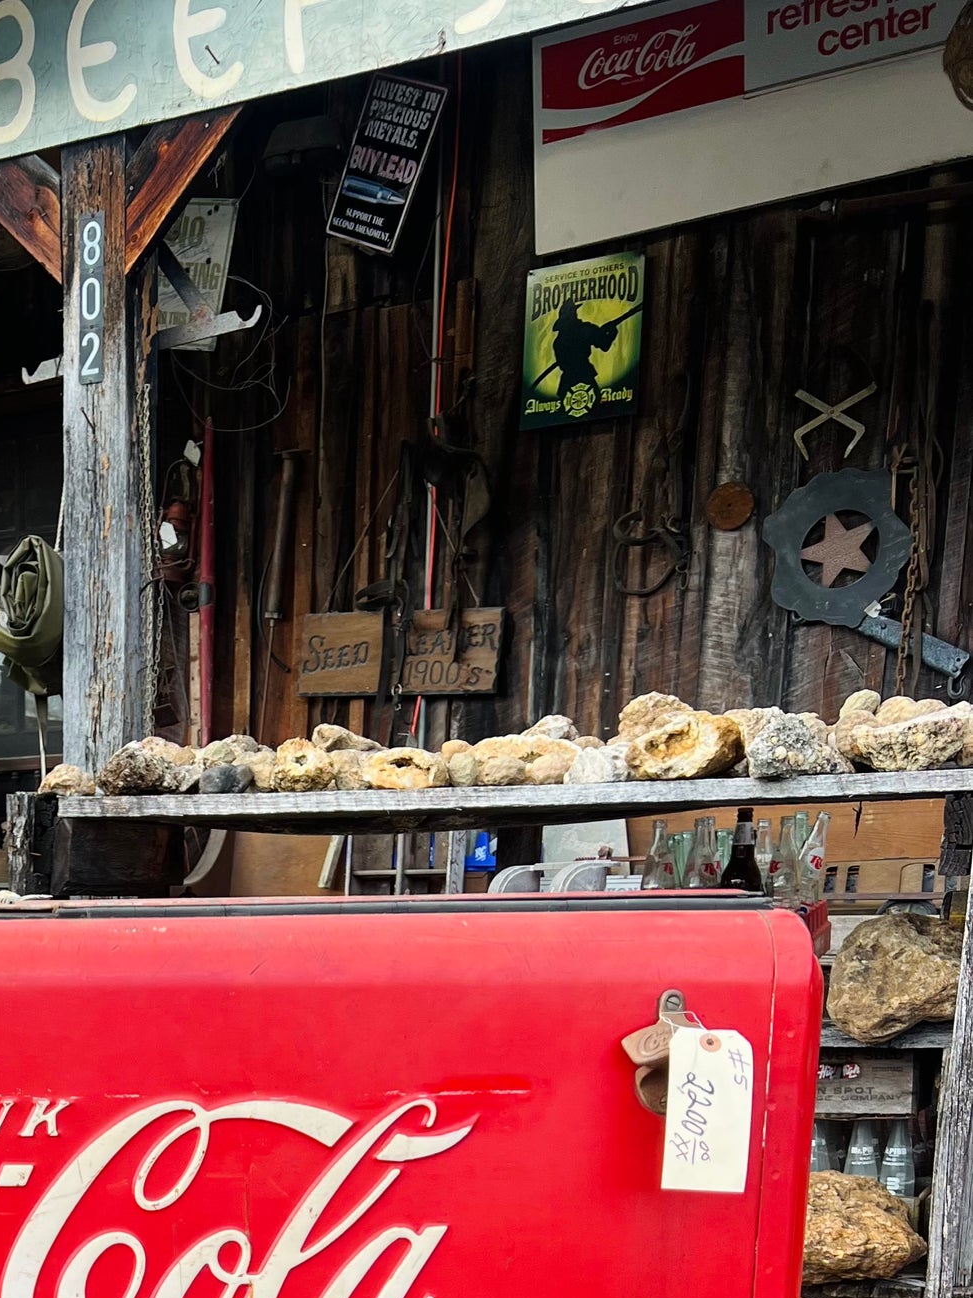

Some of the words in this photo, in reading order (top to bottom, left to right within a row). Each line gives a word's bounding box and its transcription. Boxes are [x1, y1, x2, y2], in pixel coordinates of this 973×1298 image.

[613, 32, 639, 46] Enjoy
[817, 3, 937, 56] center
[578, 22, 701, 90] Coca-Cola
[373, 80, 422, 107] INVEST
[421, 91, 441, 112] IN
[369, 99, 432, 130] PRECIOUS
[364, 120, 418, 150] METALS.
[332, 216, 355, 231] SECOND
[345, 207, 373, 223] SUPPORT
[371, 215, 385, 227] THE
[545, 271, 577, 284] SERVICE
[580, 268, 590, 277] TO
[593, 262, 625, 275] OTHERS
[531, 266, 639, 322] BROTHERHOOD
[525, 398, 562, 415] Always
[600, 387, 634, 405] Ready
[302, 635, 370, 674] SEED
[833, 1086, 875, 1095] SPOT
[841, 1094, 902, 1102] COMPANY
